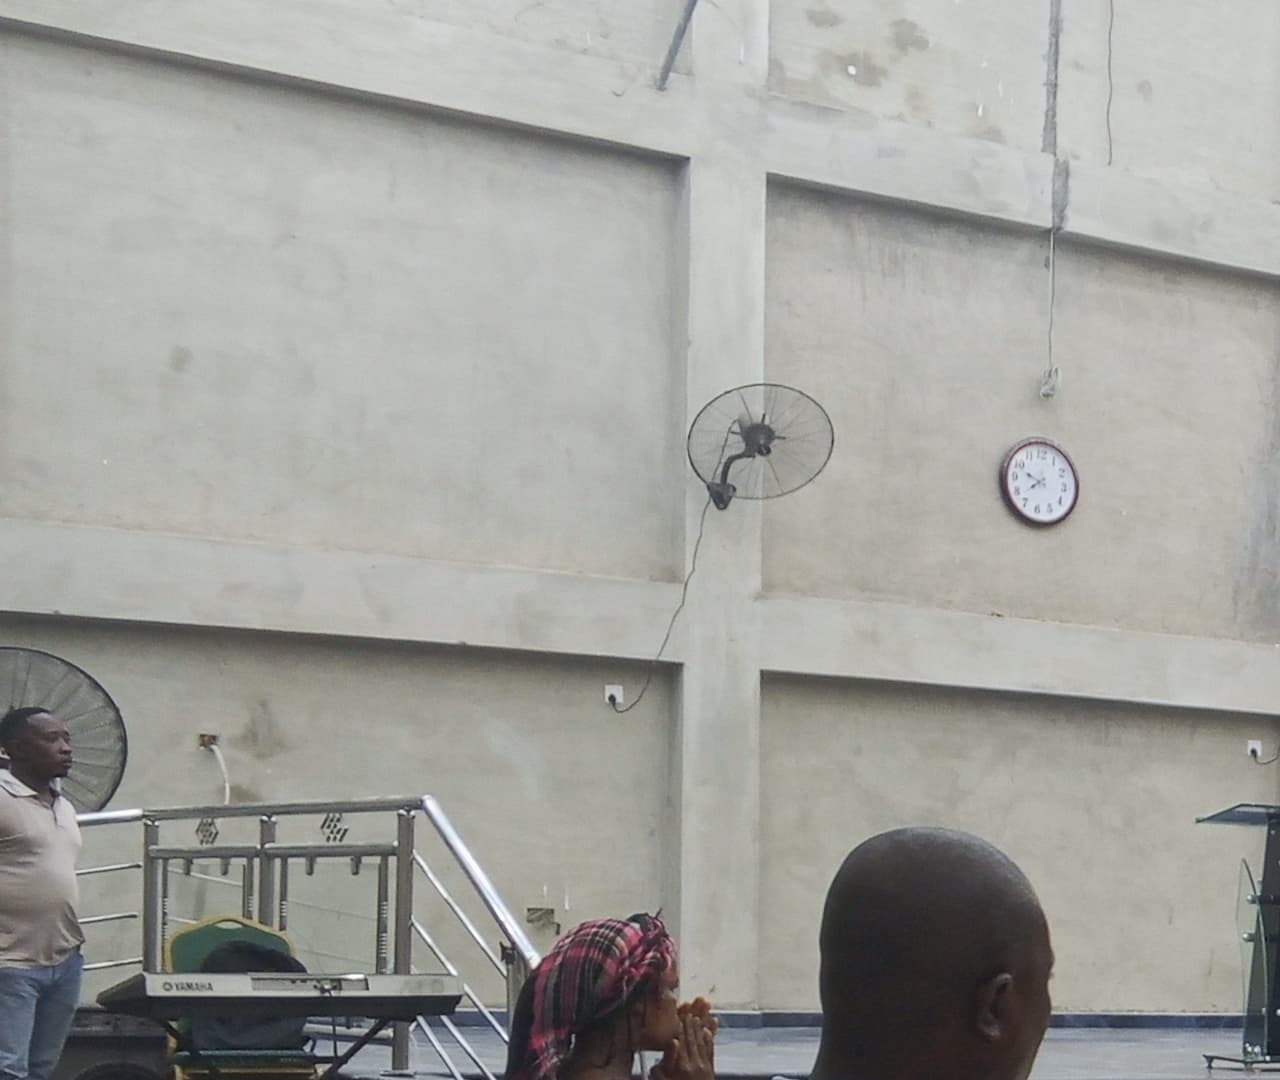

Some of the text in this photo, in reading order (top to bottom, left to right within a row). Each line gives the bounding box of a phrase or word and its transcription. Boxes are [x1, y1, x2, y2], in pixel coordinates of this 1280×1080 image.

[1026, 450, 1032, 461] 11
[1037, 449, 1047, 460] 12
[1014, 459, 1025, 469] 10
[1011, 471, 1019, 481] 9
[1058, 467, 1066, 479] 2
[1060, 482, 1068, 493] 3
[1022, 497, 1029, 508] 7
[1033, 504, 1041, 514] 6
[174, 982, 214, 991] YAMAHA
